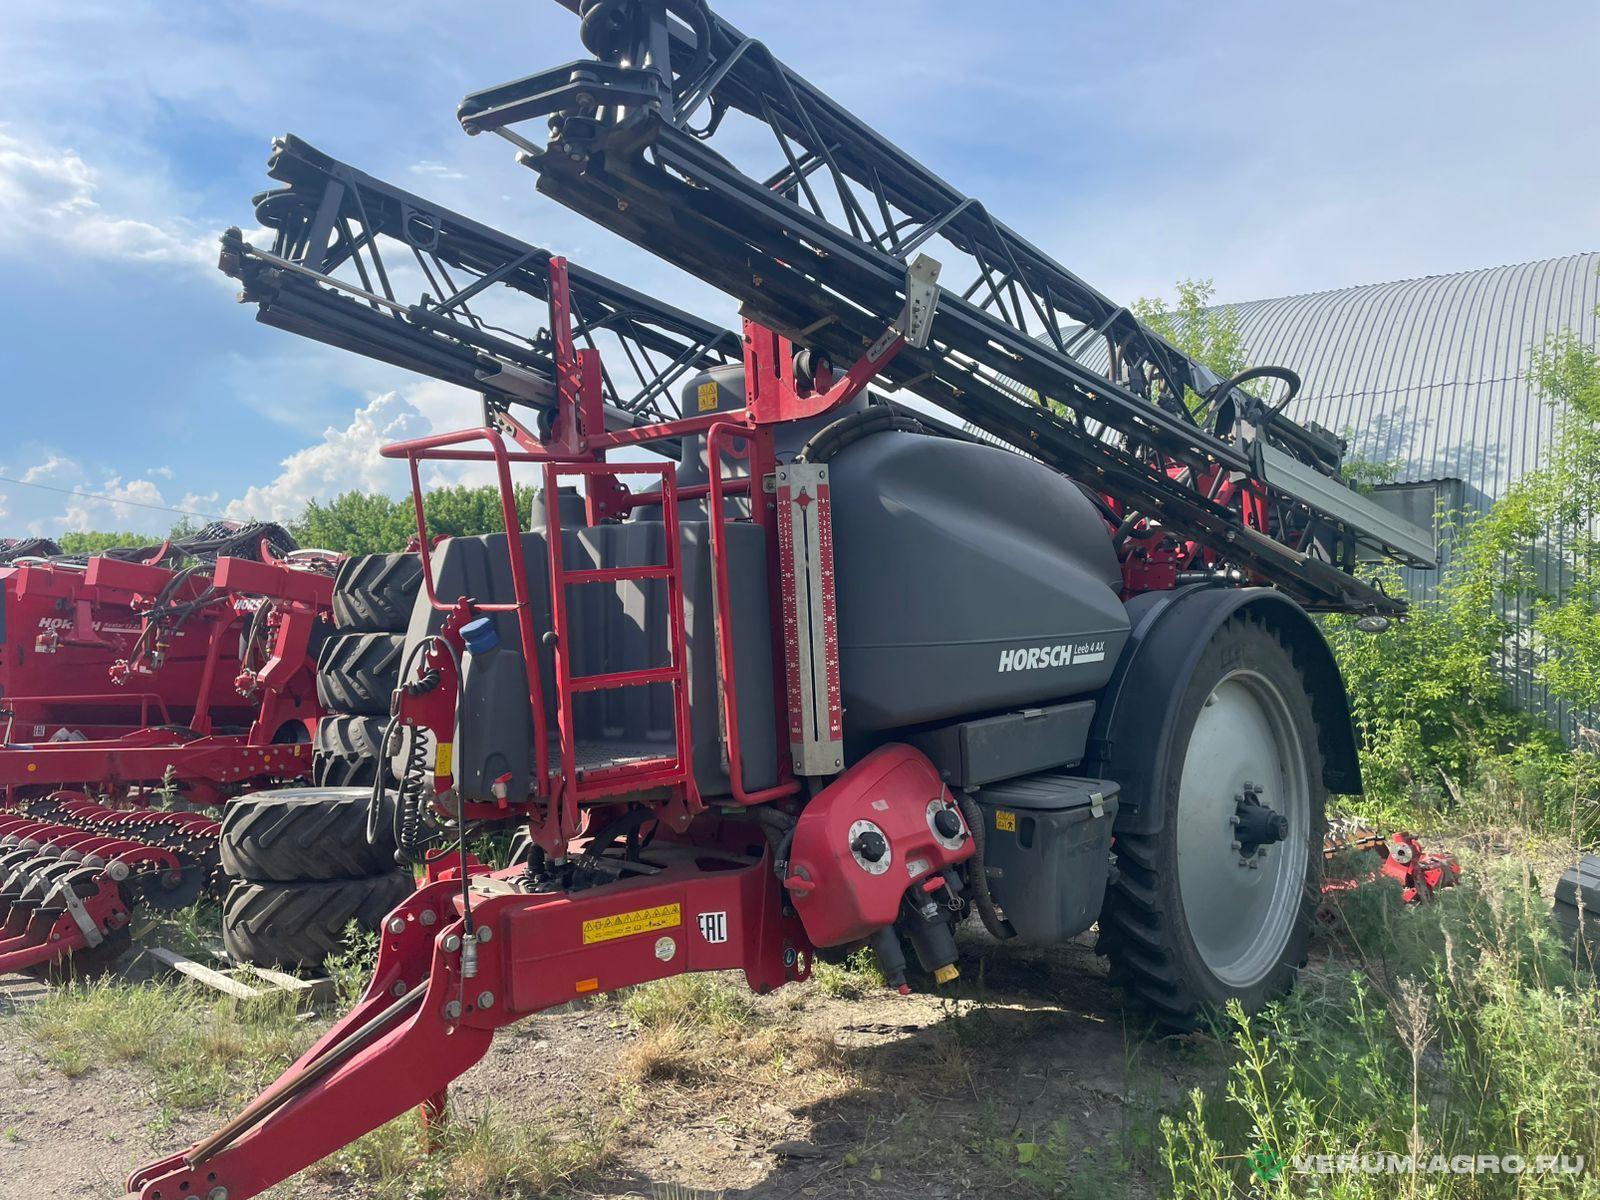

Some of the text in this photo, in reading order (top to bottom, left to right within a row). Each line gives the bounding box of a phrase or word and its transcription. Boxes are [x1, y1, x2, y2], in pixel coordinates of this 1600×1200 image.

[234, 598, 262, 610] HORS
[38, 618, 102, 631] HORH
[998, 642, 1104, 672] HORSCH Leeb 4 AX
